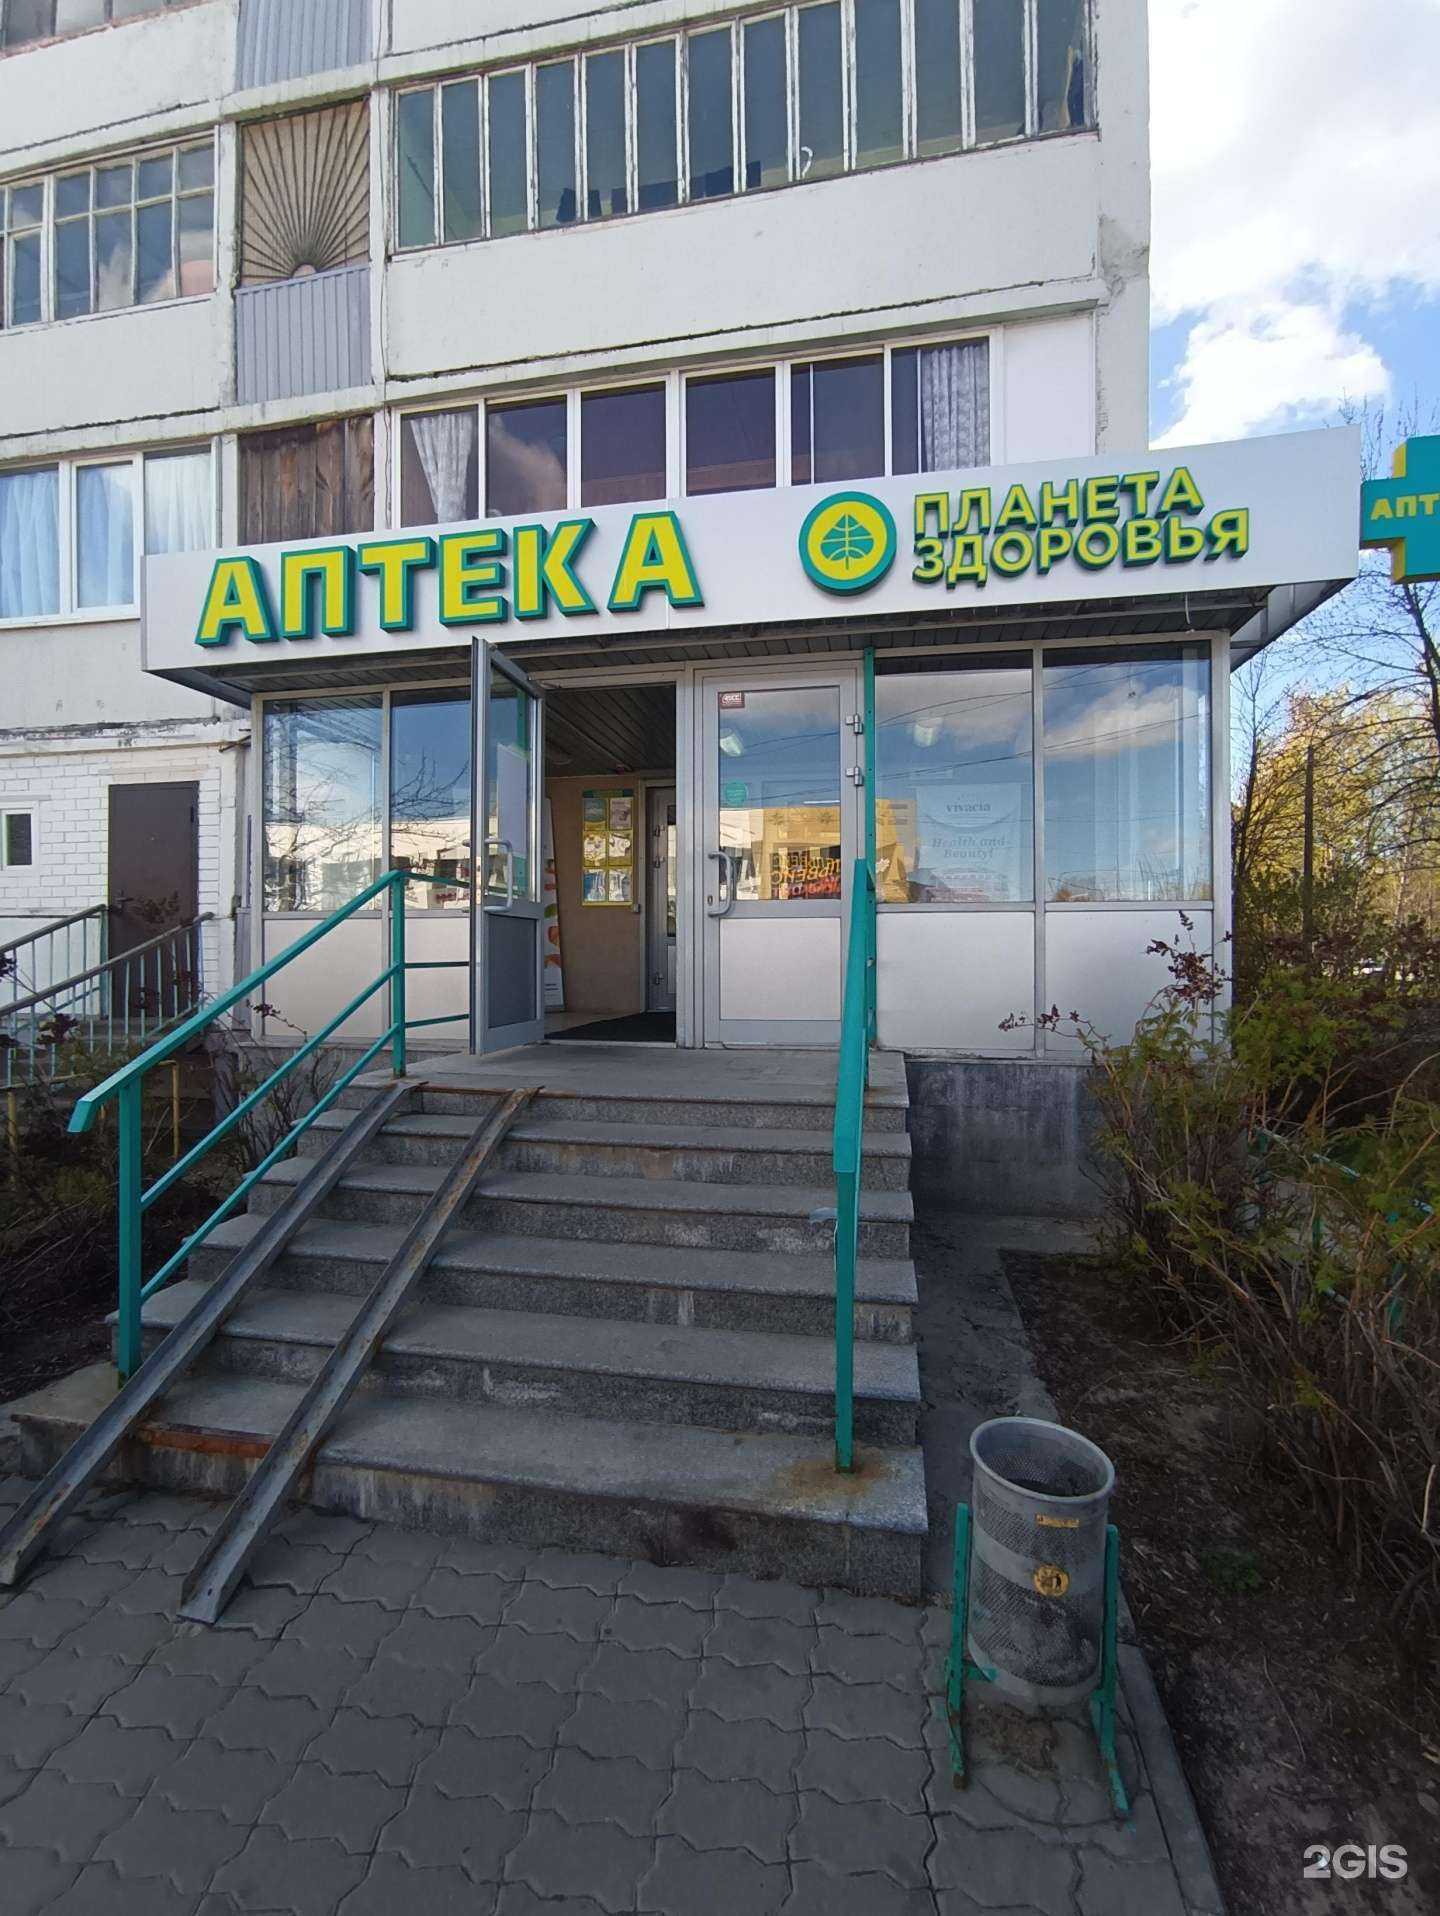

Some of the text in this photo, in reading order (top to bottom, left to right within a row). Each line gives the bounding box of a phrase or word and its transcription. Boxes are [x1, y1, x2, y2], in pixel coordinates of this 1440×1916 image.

[912, 466, 1206, 536] ПЛАНЕТА
[195, 510, 705, 647] АПТЕКА
[912, 506, 1250, 589] ЗДОРОВЬЯ
